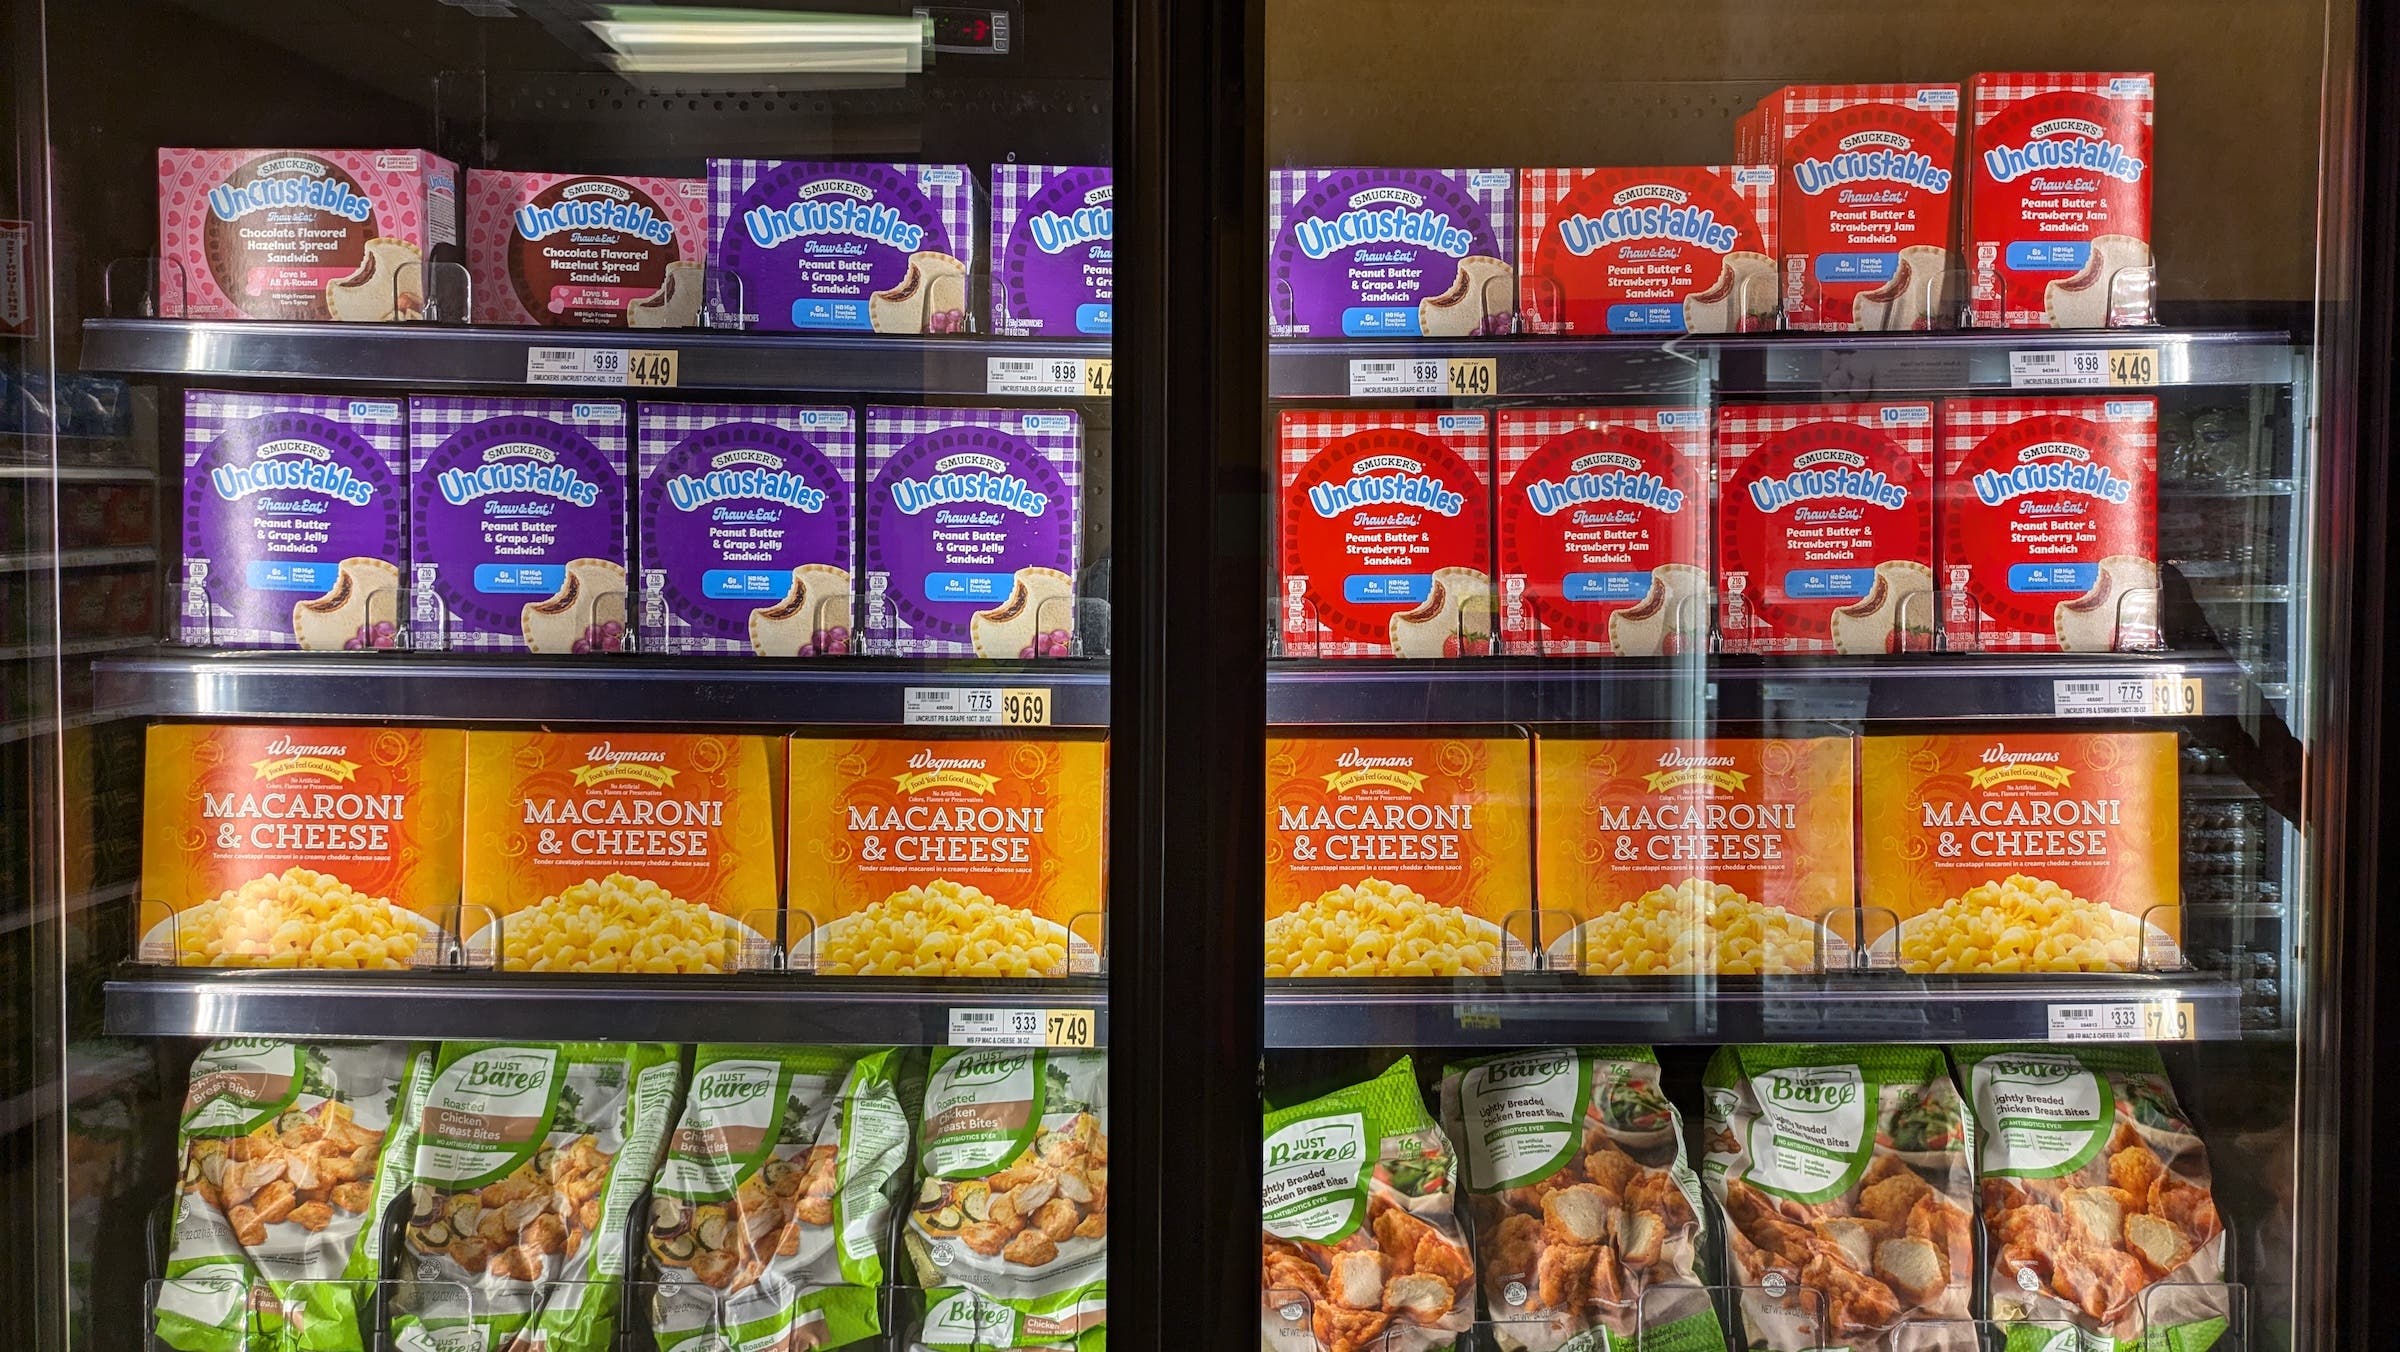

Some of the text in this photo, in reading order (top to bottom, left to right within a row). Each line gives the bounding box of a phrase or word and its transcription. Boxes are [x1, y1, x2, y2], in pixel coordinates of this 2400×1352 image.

[2035, 121, 2098, 135] SMUCKER'S
[1844, 134, 1905, 149] SMUCKER'S
[1986, 139, 2143, 180] Uncrustables
[262, 160, 322, 175] SMUCKER'S
[1796, 151, 1949, 193] Uncrustables
[568, 184, 627, 198] SMUCKER'S
[804, 182, 868, 197] SMUCKER'S
[1355, 190, 1417, 204] SMUCKER'S
[1618, 188, 1682, 202] SMUCKER'S
[210, 178, 370, 220] Uncrustables
[515, 201, 672, 242] Uncrustables
[747, 202, 921, 249] Uncrustables
[1298, 209, 1470, 255] Uncrustables
[1562, 206, 1735, 253] Uncrustables
[543, 248, 648, 260] Chocolate Flavored
[551, 260, 640, 272] Hazelnut Spread
[799, 259, 873, 271] Peanut Butter
[570, 272, 620, 283] Sandwich
[802, 273, 870, 284] & Grape Jelly
[582, 289, 600, 298] Love
[812, 284, 860, 294] Sandwich
[572, 298, 619, 306] All A-Round
[593, 355, 618, 369] $9.98
[2074, 357, 2098, 371] $8.98
[631, 357, 670, 385] $4.49
[1052, 365, 1076, 379] $8.98
[1413, 366, 1437, 379] $8.98
[2111, 357, 2150, 384] $4.49
[1451, 366, 1488, 394] $4.49
[351, 404, 366, 415] 10
[1883, 410, 1898, 421] 10
[1025, 417, 1039, 428] 10
[1439, 417, 1454, 428] 10
[263, 443, 325, 458] SMUCKER'S
[488, 445, 550, 460] SMUCKER'S
[2024, 446, 2084, 459] SMUCKER'S
[717, 452, 778, 466] SMUCKER'S
[940, 456, 1001, 470] SMUCKER'S
[1358, 458, 1417, 471] SMUCKER'S
[1576, 456, 1636, 469] SMUCKER'S
[1798, 452, 1859, 465] SMUCKER'S
[214, 460, 372, 503] Uncrustables
[440, 463, 597, 504] Uncrustables
[1975, 463, 2130, 503] Uncrustables
[669, 469, 824, 510] Uncrustables
[893, 473, 1045, 515] Uncrustables
[1311, 475, 1462, 515] Uncrustables
[1529, 471, 1682, 513] Uncrustables
[1751, 469, 1906, 510] Uncrustables
[481, 522, 557, 532] Peanut Butter
[495, 534, 528, 546] Grape
[531, 534, 554, 545] Jelly
[1346, 533, 1429, 542] Peanut Butter &
[495, 546, 544, 555] Sandwich
[1346, 545, 1429, 555] Strawberry Jam
[1364, 556, 1411, 565] Sandwich
[2118, 686, 2143, 700] $7.75
[968, 695, 992, 708] $7.75
[1004, 696, 1043, 724] $9.69
[265, 735, 347, 762] Wegmans
[586, 741, 665, 768] Wegmans
[908, 749, 986, 775] Wegmans
[1335, 748, 1413, 774] Wegmans
[1657, 747, 1735, 773] Wegmans
[1980, 743, 2059, 770] Wegmans
[1339, 778, 1354, 788] Food
[1355, 775, 1364, 783] You
[1365, 773, 1376, 781] Feel
[1377, 773, 1392, 781] Good
[203, 793, 405, 819] MACARONI
[524, 799, 723, 826] MACARONI
[1923, 800, 2120, 827] MACARONI
[848, 806, 1044, 833] MACARONI
[1279, 805, 1472, 830] MACARONI
[1600, 804, 1795, 830] MACARONI
[216, 824, 389, 850] & CHEESE
[538, 829, 707, 856] & CHEESE
[1938, 831, 2106, 856] & CHEESE
[862, 836, 1029, 862] & CHEESE
[1293, 835, 1459, 860] & CHEESE
[1615, 835, 1782, 860] & CHEESE
[1012, 1016, 1036, 1030] $3.33
[2112, 1012, 2135, 1025] $3.33
[1049, 1018, 1087, 1045] $7.49
[977, 1052, 1003, 1061] JUST
[492, 1062, 521, 1070] JUST
[955, 1058, 1008, 1079] Bare
[1489, 1060, 1552, 1083] Bare
[469, 1062, 527, 1088] Bare
[717, 1073, 745, 1082] JUST
[701, 1076, 751, 1099] Bare
[1772, 1077, 1839, 1104] Bare
[443, 1098, 485, 1112] Roasted
[937, 1093, 975, 1111] Roasted
[1508, 1098, 1544, 1109] Breaded
[2026, 1095, 2064, 1105] Breaded
[1516, 1110, 1544, 1118] Breast
[2035, 1106, 2063, 1116] Breast
[441, 1112, 482, 1126] Chicken
[970, 1117, 997, 1128] Bites
[439, 1124, 500, 1140] Breast Bites
[1293, 1137, 1326, 1149] JUST
[1399, 1139, 1421, 1151] 16g
[1827, 1138, 1849, 1147] Bites
[1270, 1143, 1335, 1167] Bare
[1287, 1167, 1326, 1188] Breaded
[1297, 1176, 1348, 1197] Breast Bites
[951, 1301, 996, 1322] Bare
[1027, 1319, 1060, 1330] Chicken
